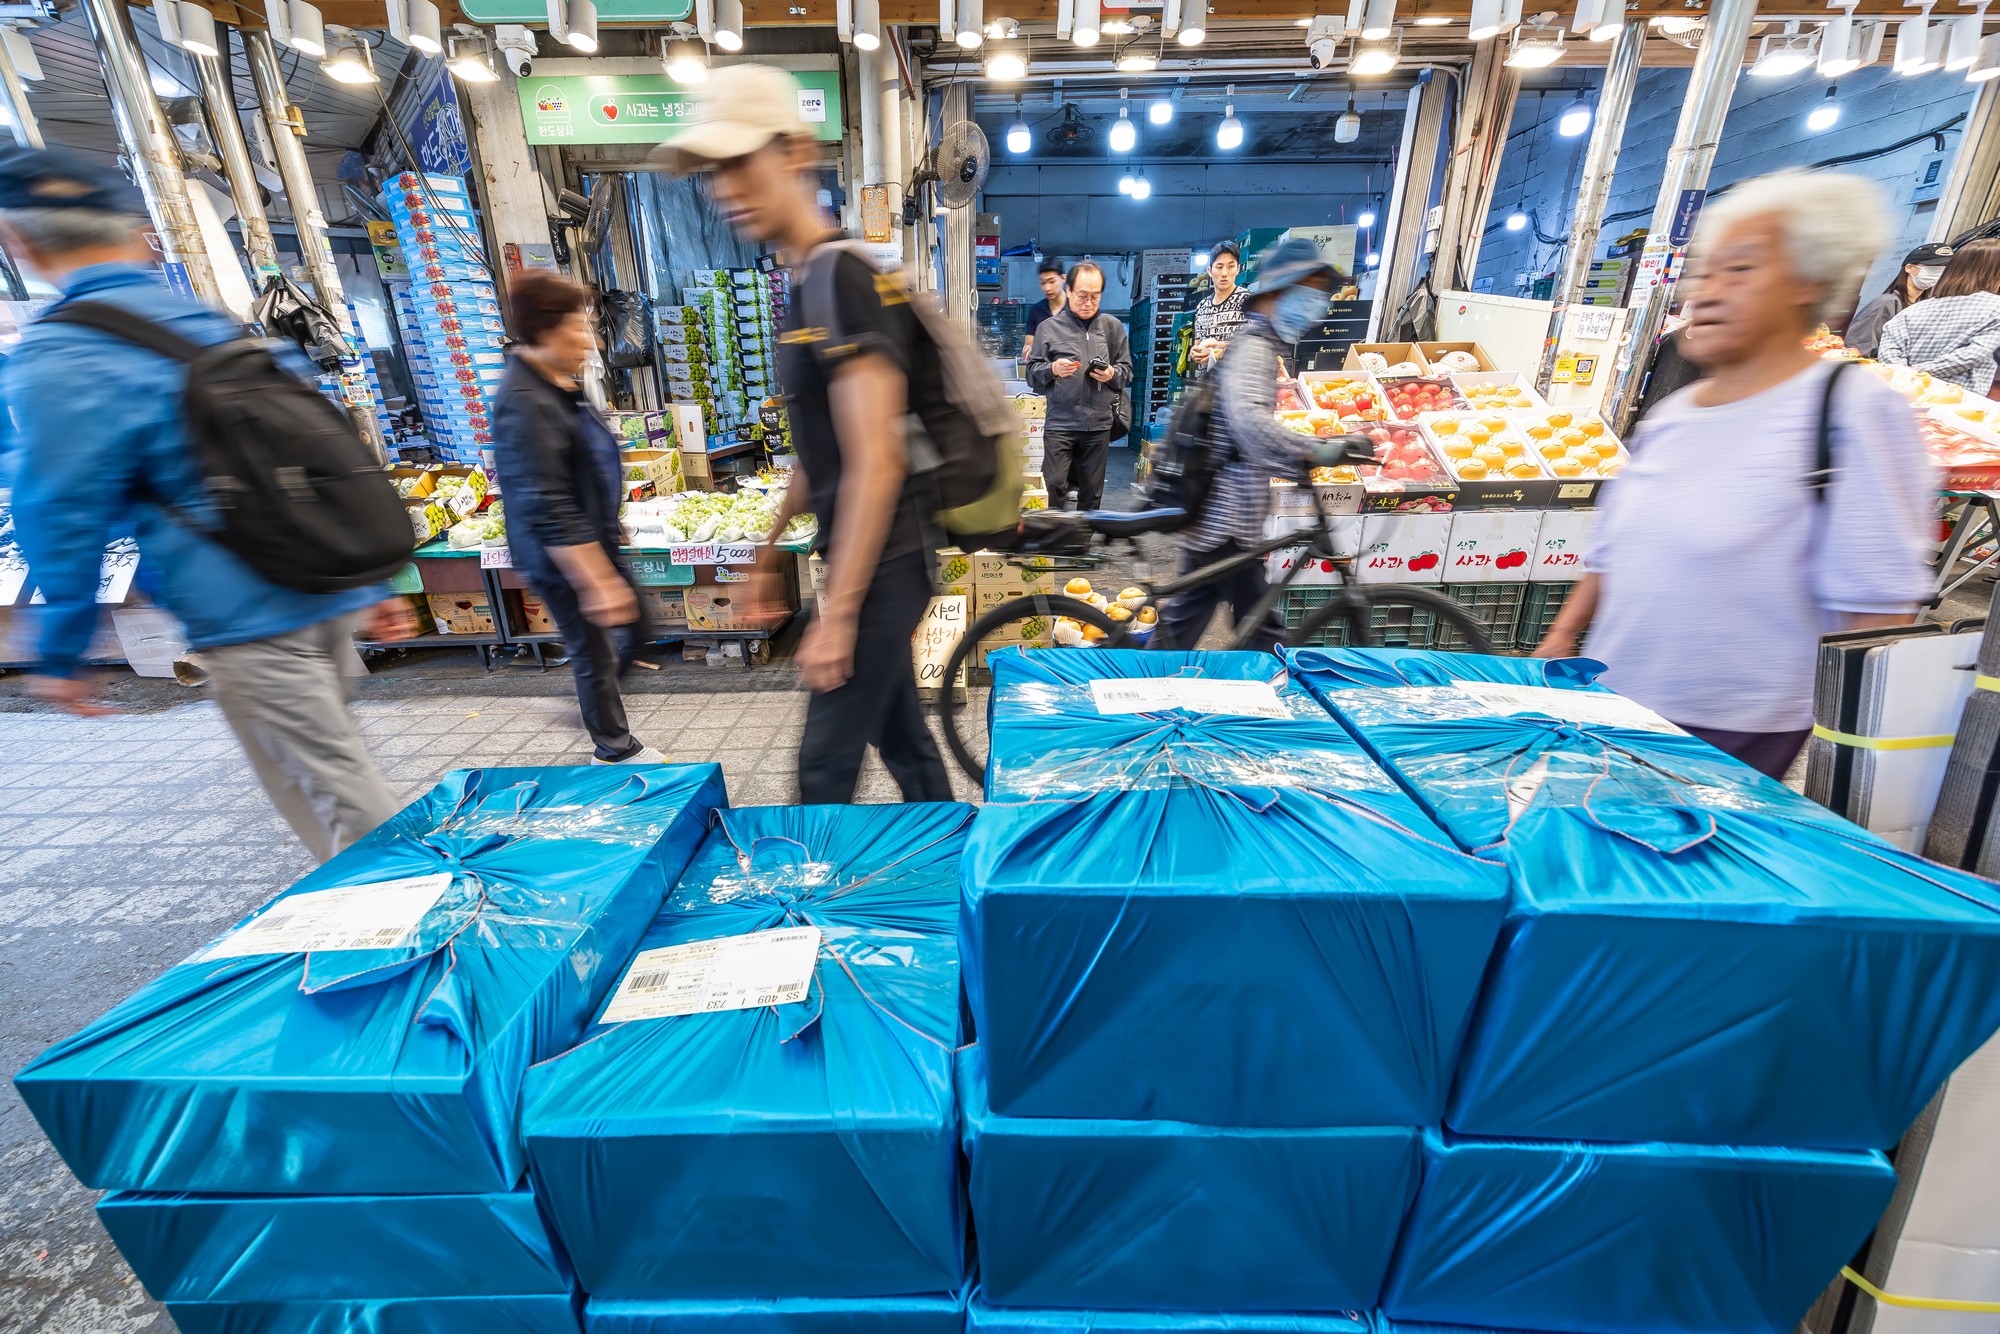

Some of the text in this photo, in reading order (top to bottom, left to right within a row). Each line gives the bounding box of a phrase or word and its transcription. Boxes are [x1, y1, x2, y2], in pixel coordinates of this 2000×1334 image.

[625, 103, 659, 117] 사과는
[538, 125, 574, 137] 한도상사
[1376, 497, 1400, 508] 사과
[1368, 557, 1404, 569] 사과
[1456, 554, 1492, 566] 사과
[1543, 553, 1581, 566] 사과
[928, 602, 961, 621] 샤인
[303, 938, 395, 949] MH 580 C 321
[757, 995, 778, 1004] 409
[786, 991, 800, 1001] SS
[706, 1000, 727, 1010] 733
